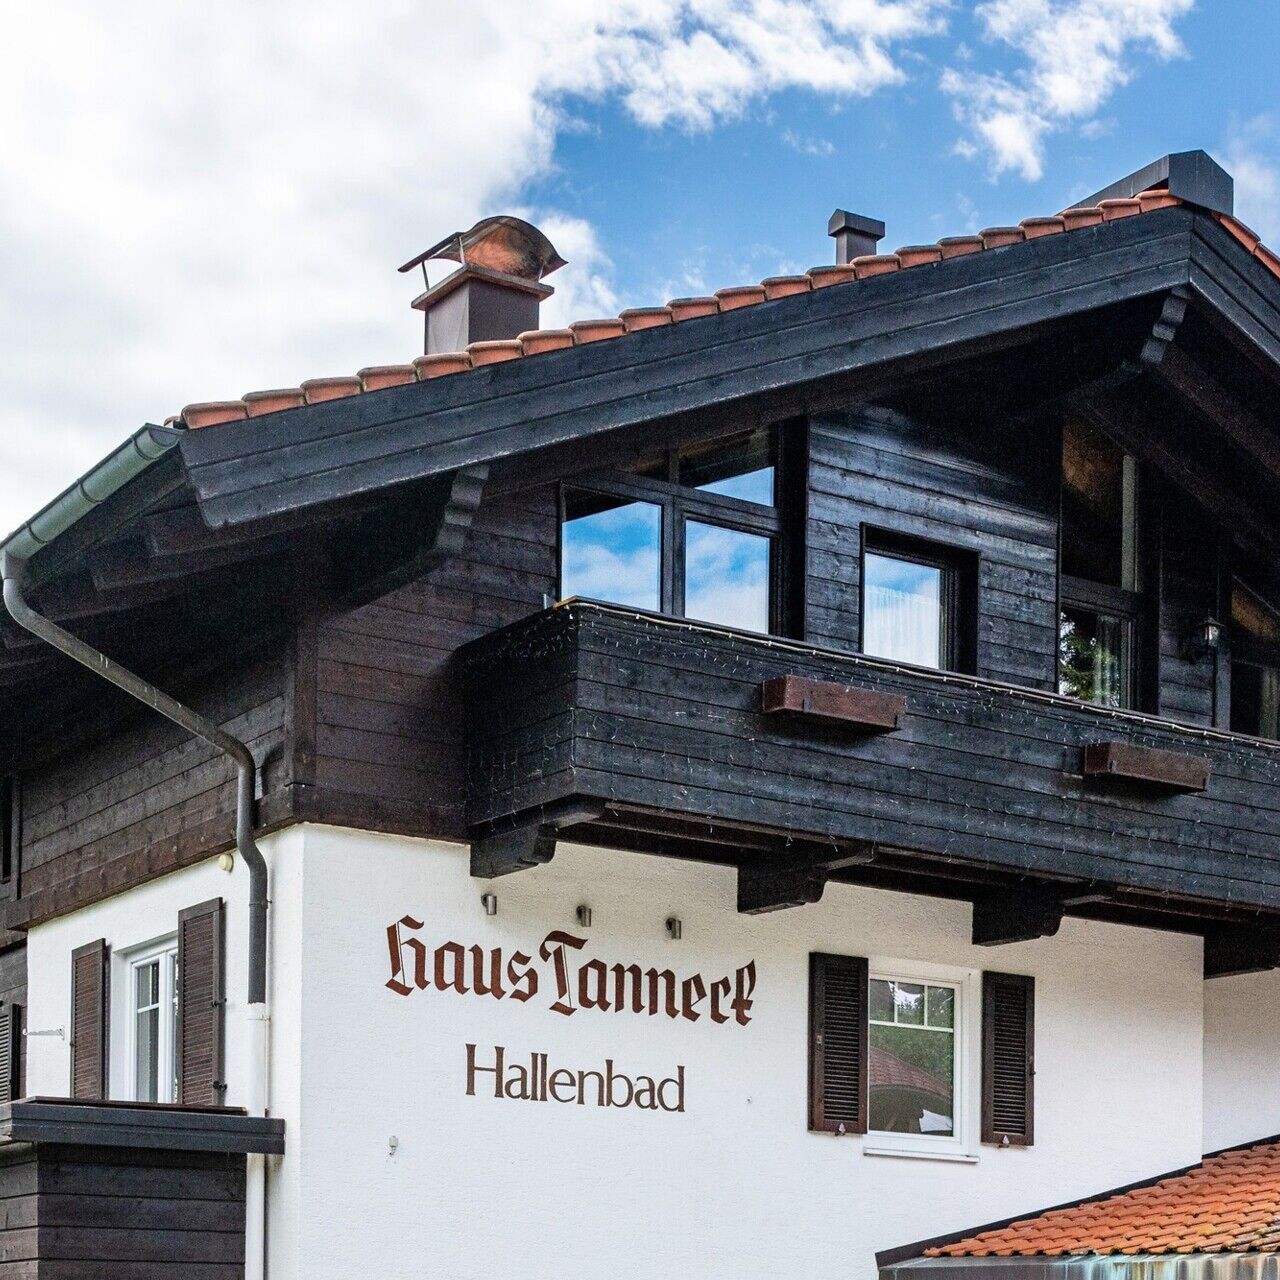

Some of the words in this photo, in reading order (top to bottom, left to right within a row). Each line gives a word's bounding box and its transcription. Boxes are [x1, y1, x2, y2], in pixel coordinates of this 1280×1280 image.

[385, 914, 539, 1003] Haus
[539, 930, 757, 1026] Tanneck
[465, 1043, 685, 1113] Hallenbad
